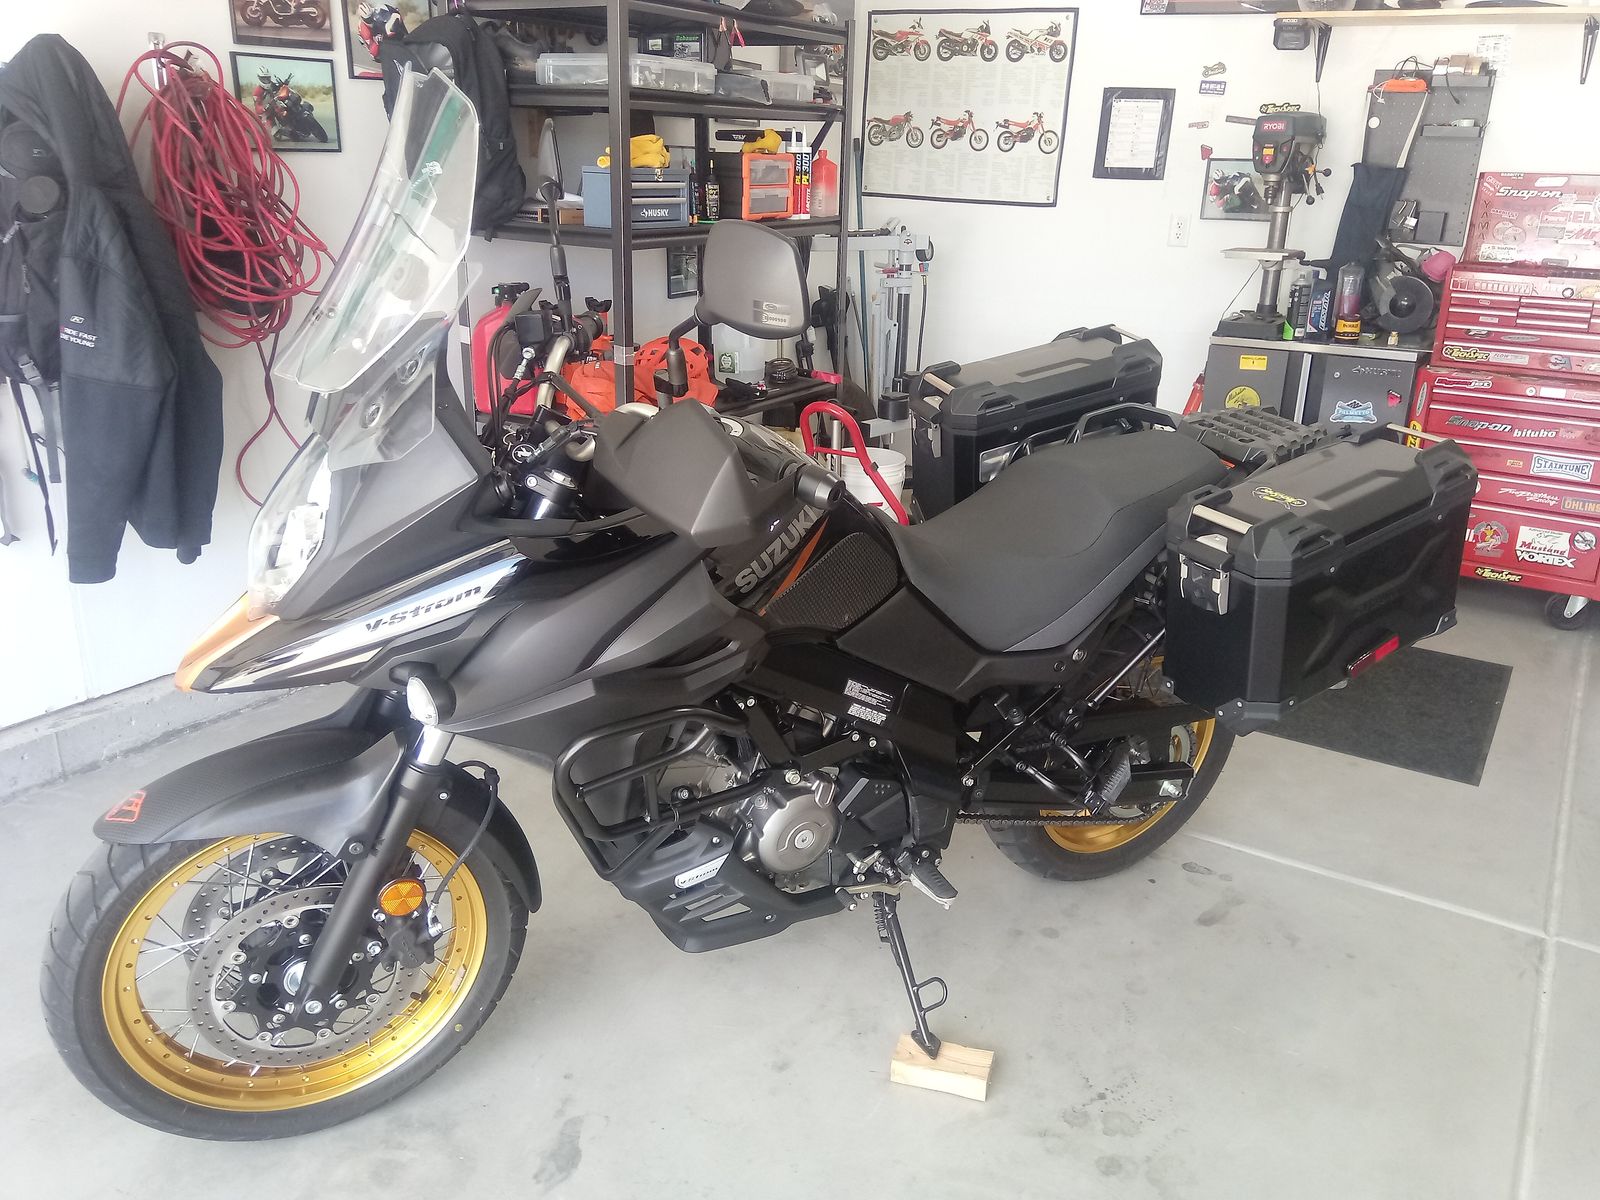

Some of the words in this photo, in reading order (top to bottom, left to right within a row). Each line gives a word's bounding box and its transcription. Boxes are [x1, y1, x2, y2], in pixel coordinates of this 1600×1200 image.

[1263, 122, 1285, 130] RYOBI
[801, 153, 811, 173] 300
[801, 174, 809, 185] PL
[648, 208, 670, 217] HUSKY
[79, 331, 98, 341] FAST
[1512, 428, 1558, 439] bitubo
[1535, 458, 1589, 475] STAINTUNE
[735, 504, 820, 594] SUZUKI
[1519, 540, 1567, 556] Mustang
[1515, 550, 1577, 568] VORTEX
[365, 585, 482, 633] V-Strom
